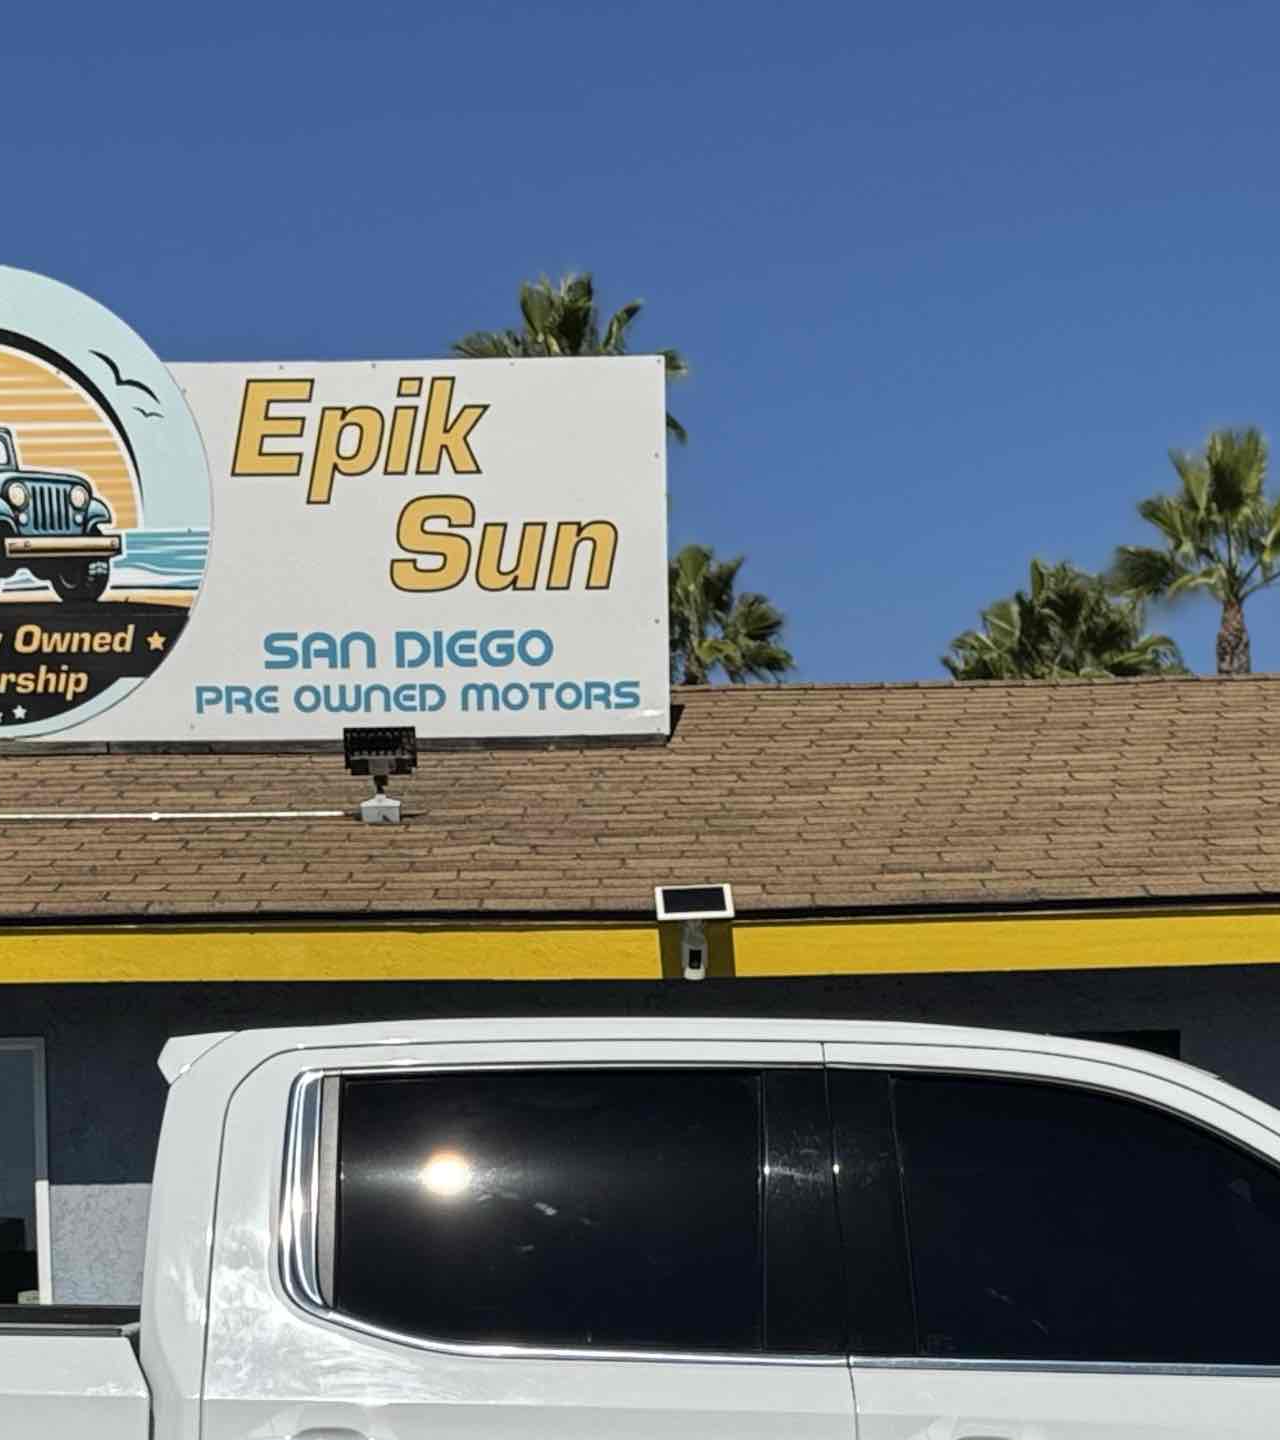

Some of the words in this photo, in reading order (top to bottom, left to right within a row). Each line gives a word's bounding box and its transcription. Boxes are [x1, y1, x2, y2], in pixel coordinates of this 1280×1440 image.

[231, 376, 490, 504] Epik
[389, 494, 618, 593] Sun
[14, 623, 136, 654] Owned
[263, 631, 376, 669] SAN
[395, 629, 554, 668] DIEGO
[195, 685, 280, 714] PRE
[293, 683, 447, 713] OWNED
[460, 681, 641, 711] MOTORS
